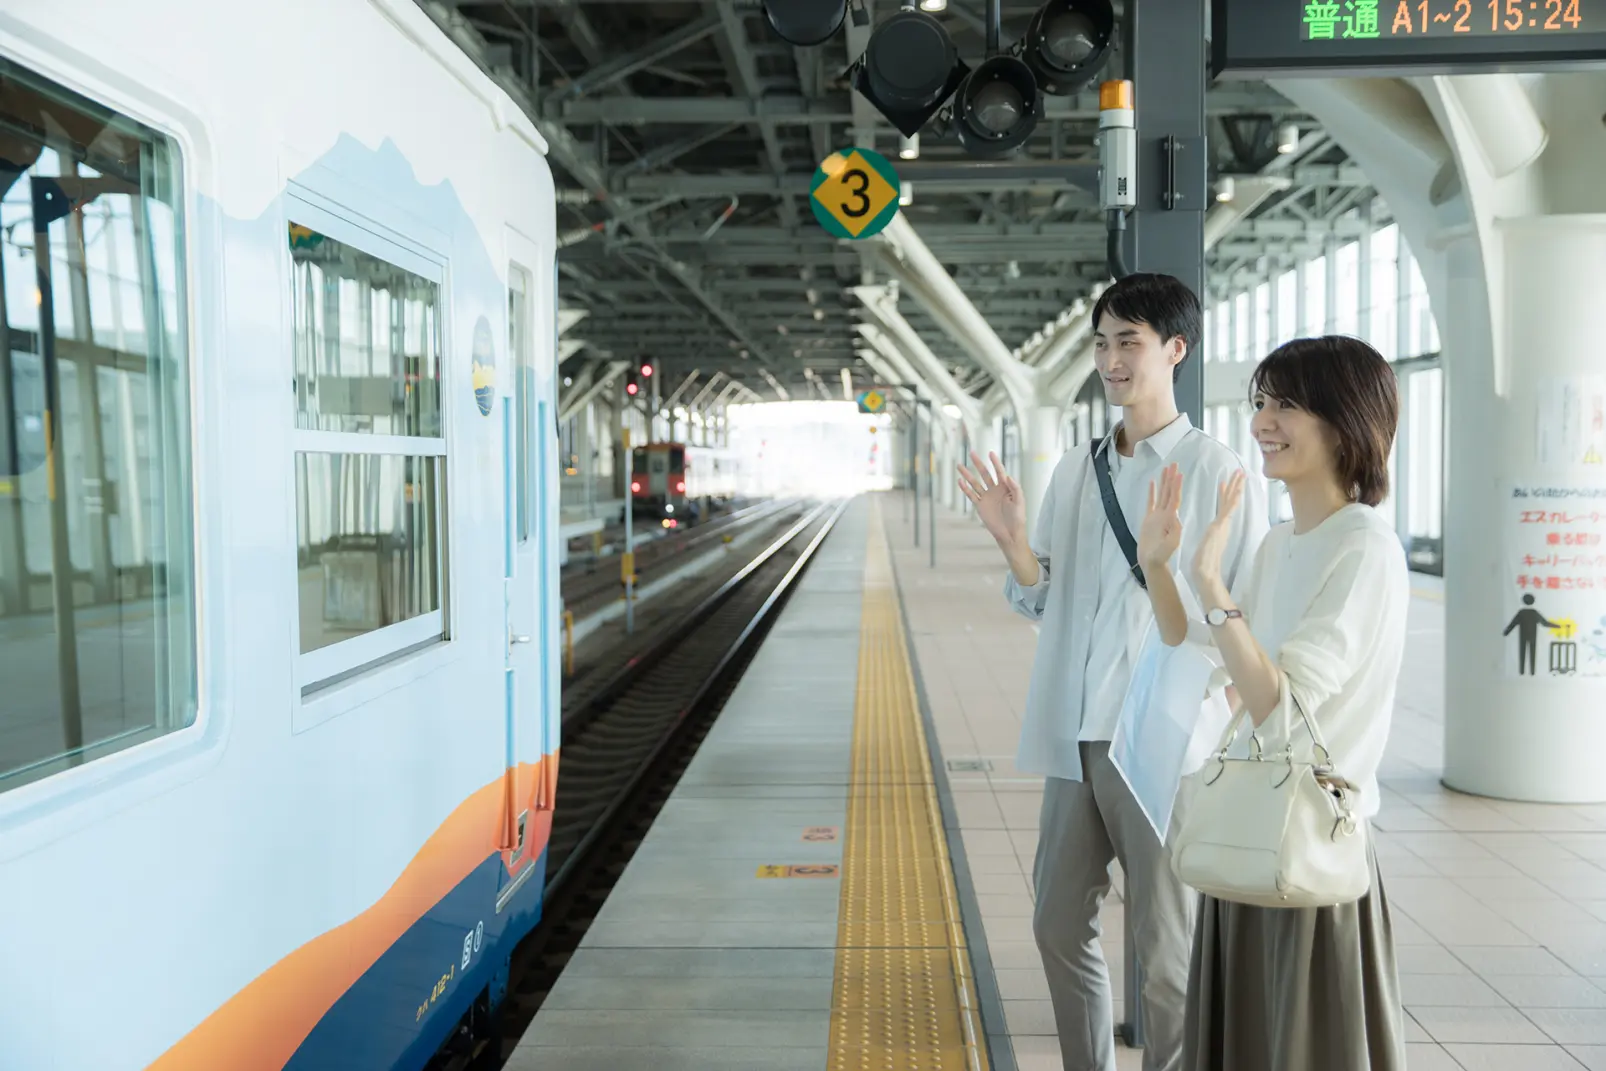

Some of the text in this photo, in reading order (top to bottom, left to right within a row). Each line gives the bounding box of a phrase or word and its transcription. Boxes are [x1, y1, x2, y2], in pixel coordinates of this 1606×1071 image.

[1302, 0, 1381, 40] 普通
[1488, 0, 1583, 32] 15:24
[840, 168, 871, 218] 3
